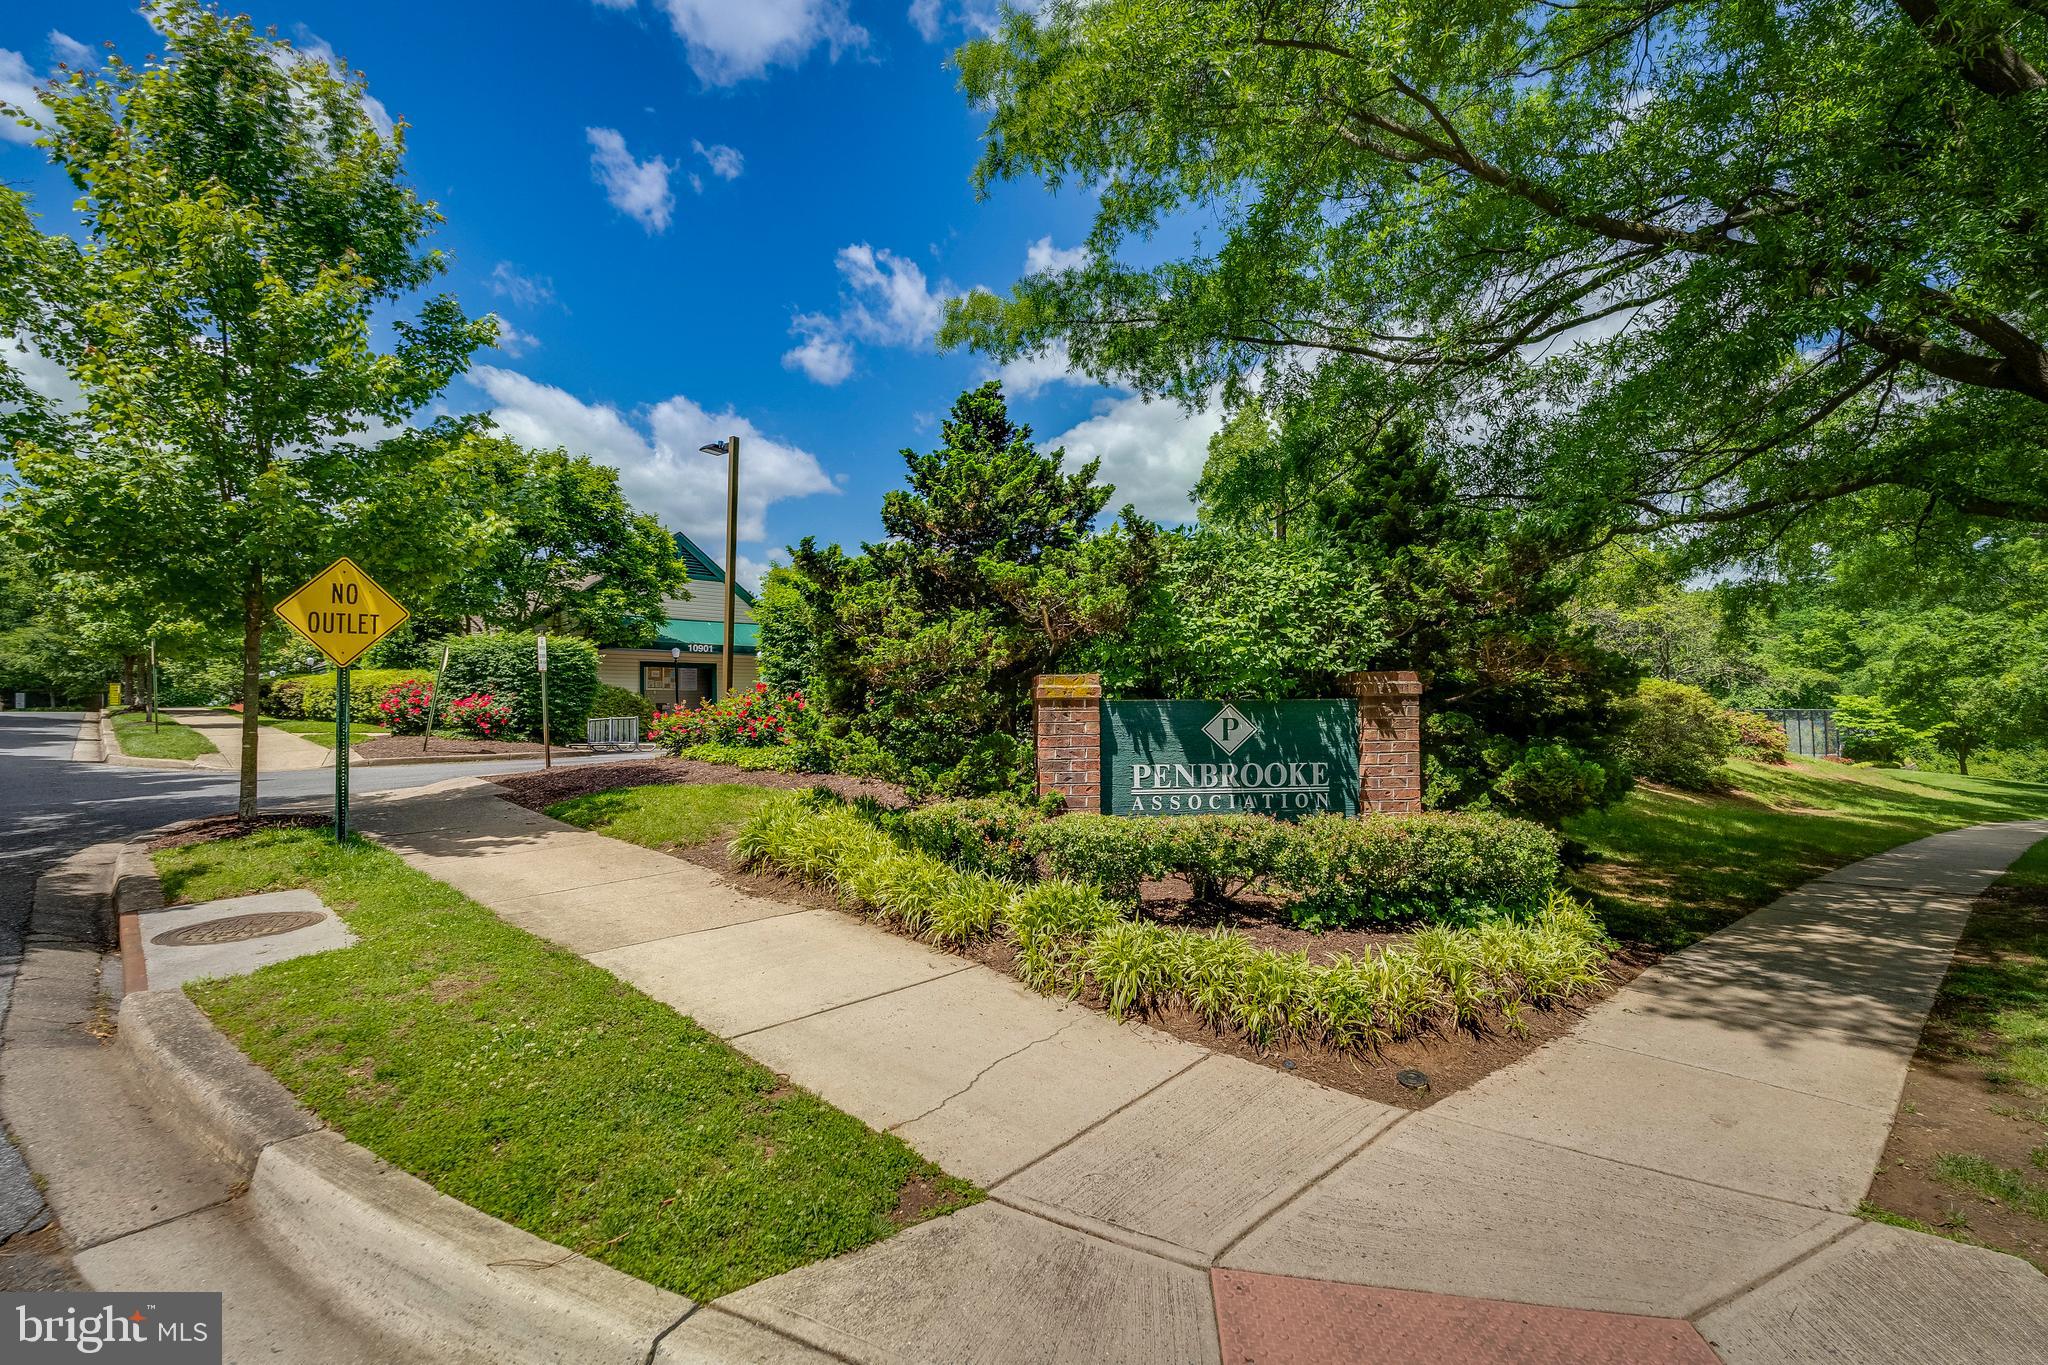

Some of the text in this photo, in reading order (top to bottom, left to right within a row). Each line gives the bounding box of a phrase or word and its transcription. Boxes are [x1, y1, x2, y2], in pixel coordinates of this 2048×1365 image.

[332, 583, 358, 604] NO
[308, 611, 379, 635] OUTLET
[688, 644, 713, 652] 10901
[1221, 717, 1239, 741] P
[1131, 762, 1329, 789] PENBROOKE
[1132, 793, 1329, 811] ASSOCIATION
